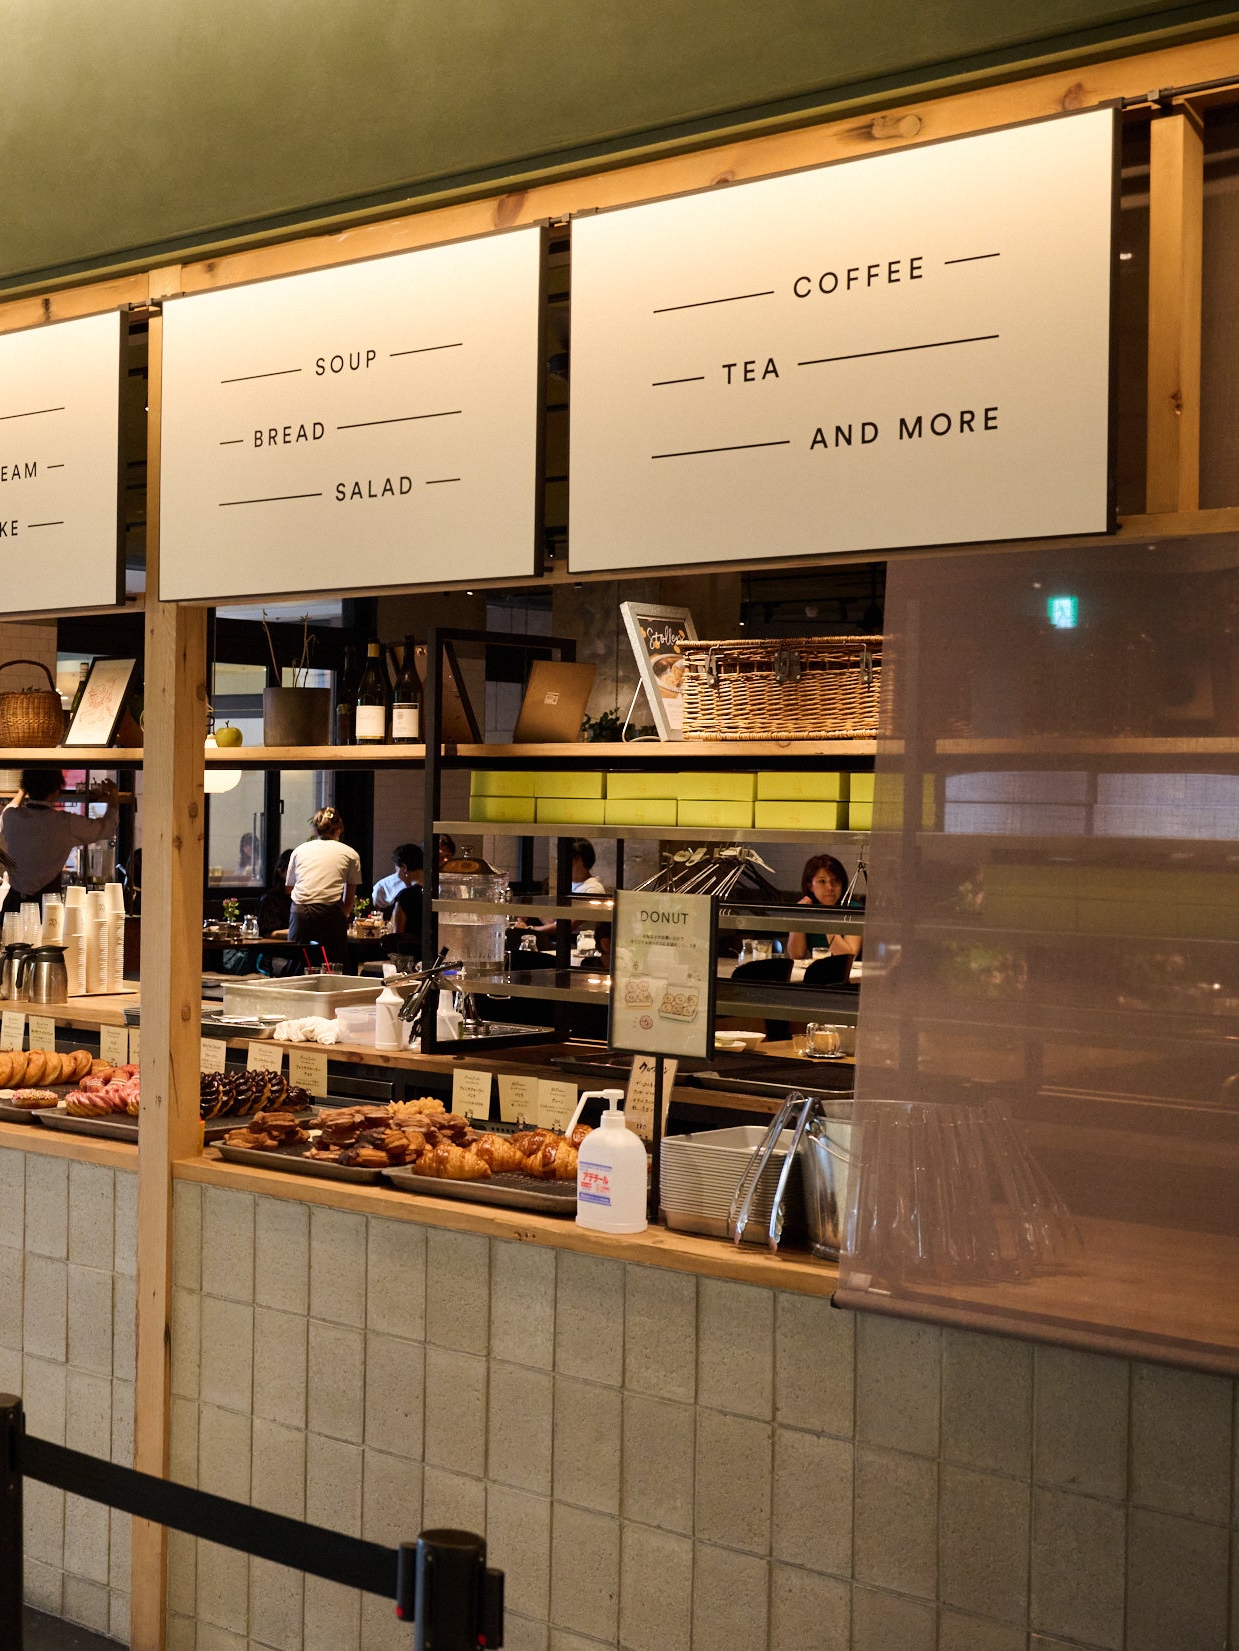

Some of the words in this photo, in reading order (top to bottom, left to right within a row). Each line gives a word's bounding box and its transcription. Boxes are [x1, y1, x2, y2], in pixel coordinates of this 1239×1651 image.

[794, 257, 922, 298] COFFEE
[316, 350, 376, 376] SOUP
[722, 358, 779, 384] TEA
[255, 422, 324, 447] BREAD
[810, 422, 878, 450] AND
[899, 407, 998, 440] MORE
[336, 476, 412, 501] SALAD
[642, 911, 688, 924] DONUT
